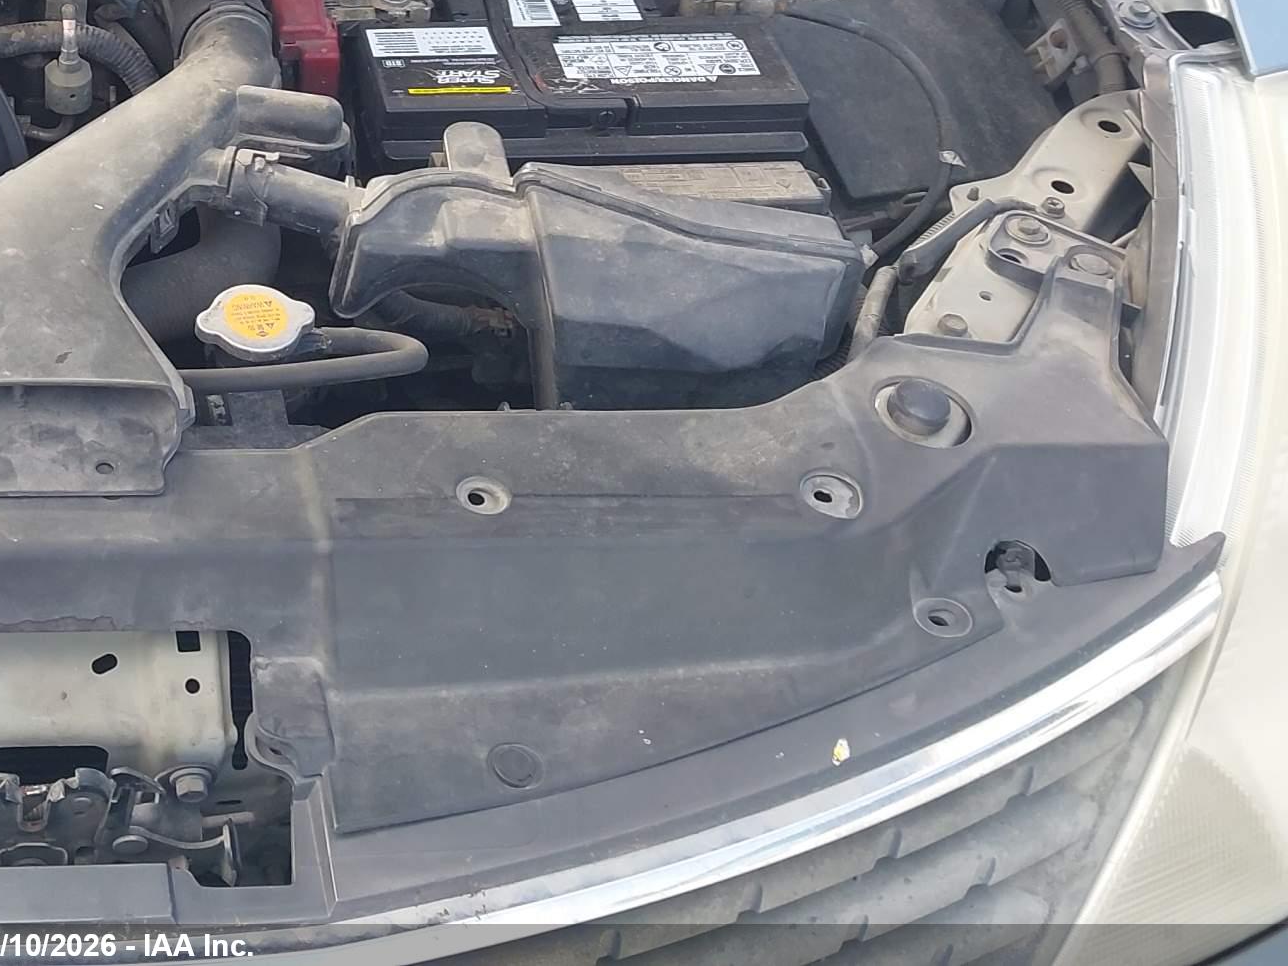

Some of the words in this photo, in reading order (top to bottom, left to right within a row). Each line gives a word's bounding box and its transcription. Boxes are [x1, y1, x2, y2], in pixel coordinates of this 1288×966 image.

[436, 69, 501, 78] START
[437, 76, 496, 84] SUPER
[609, 75, 707, 85] DANGER/POISON
